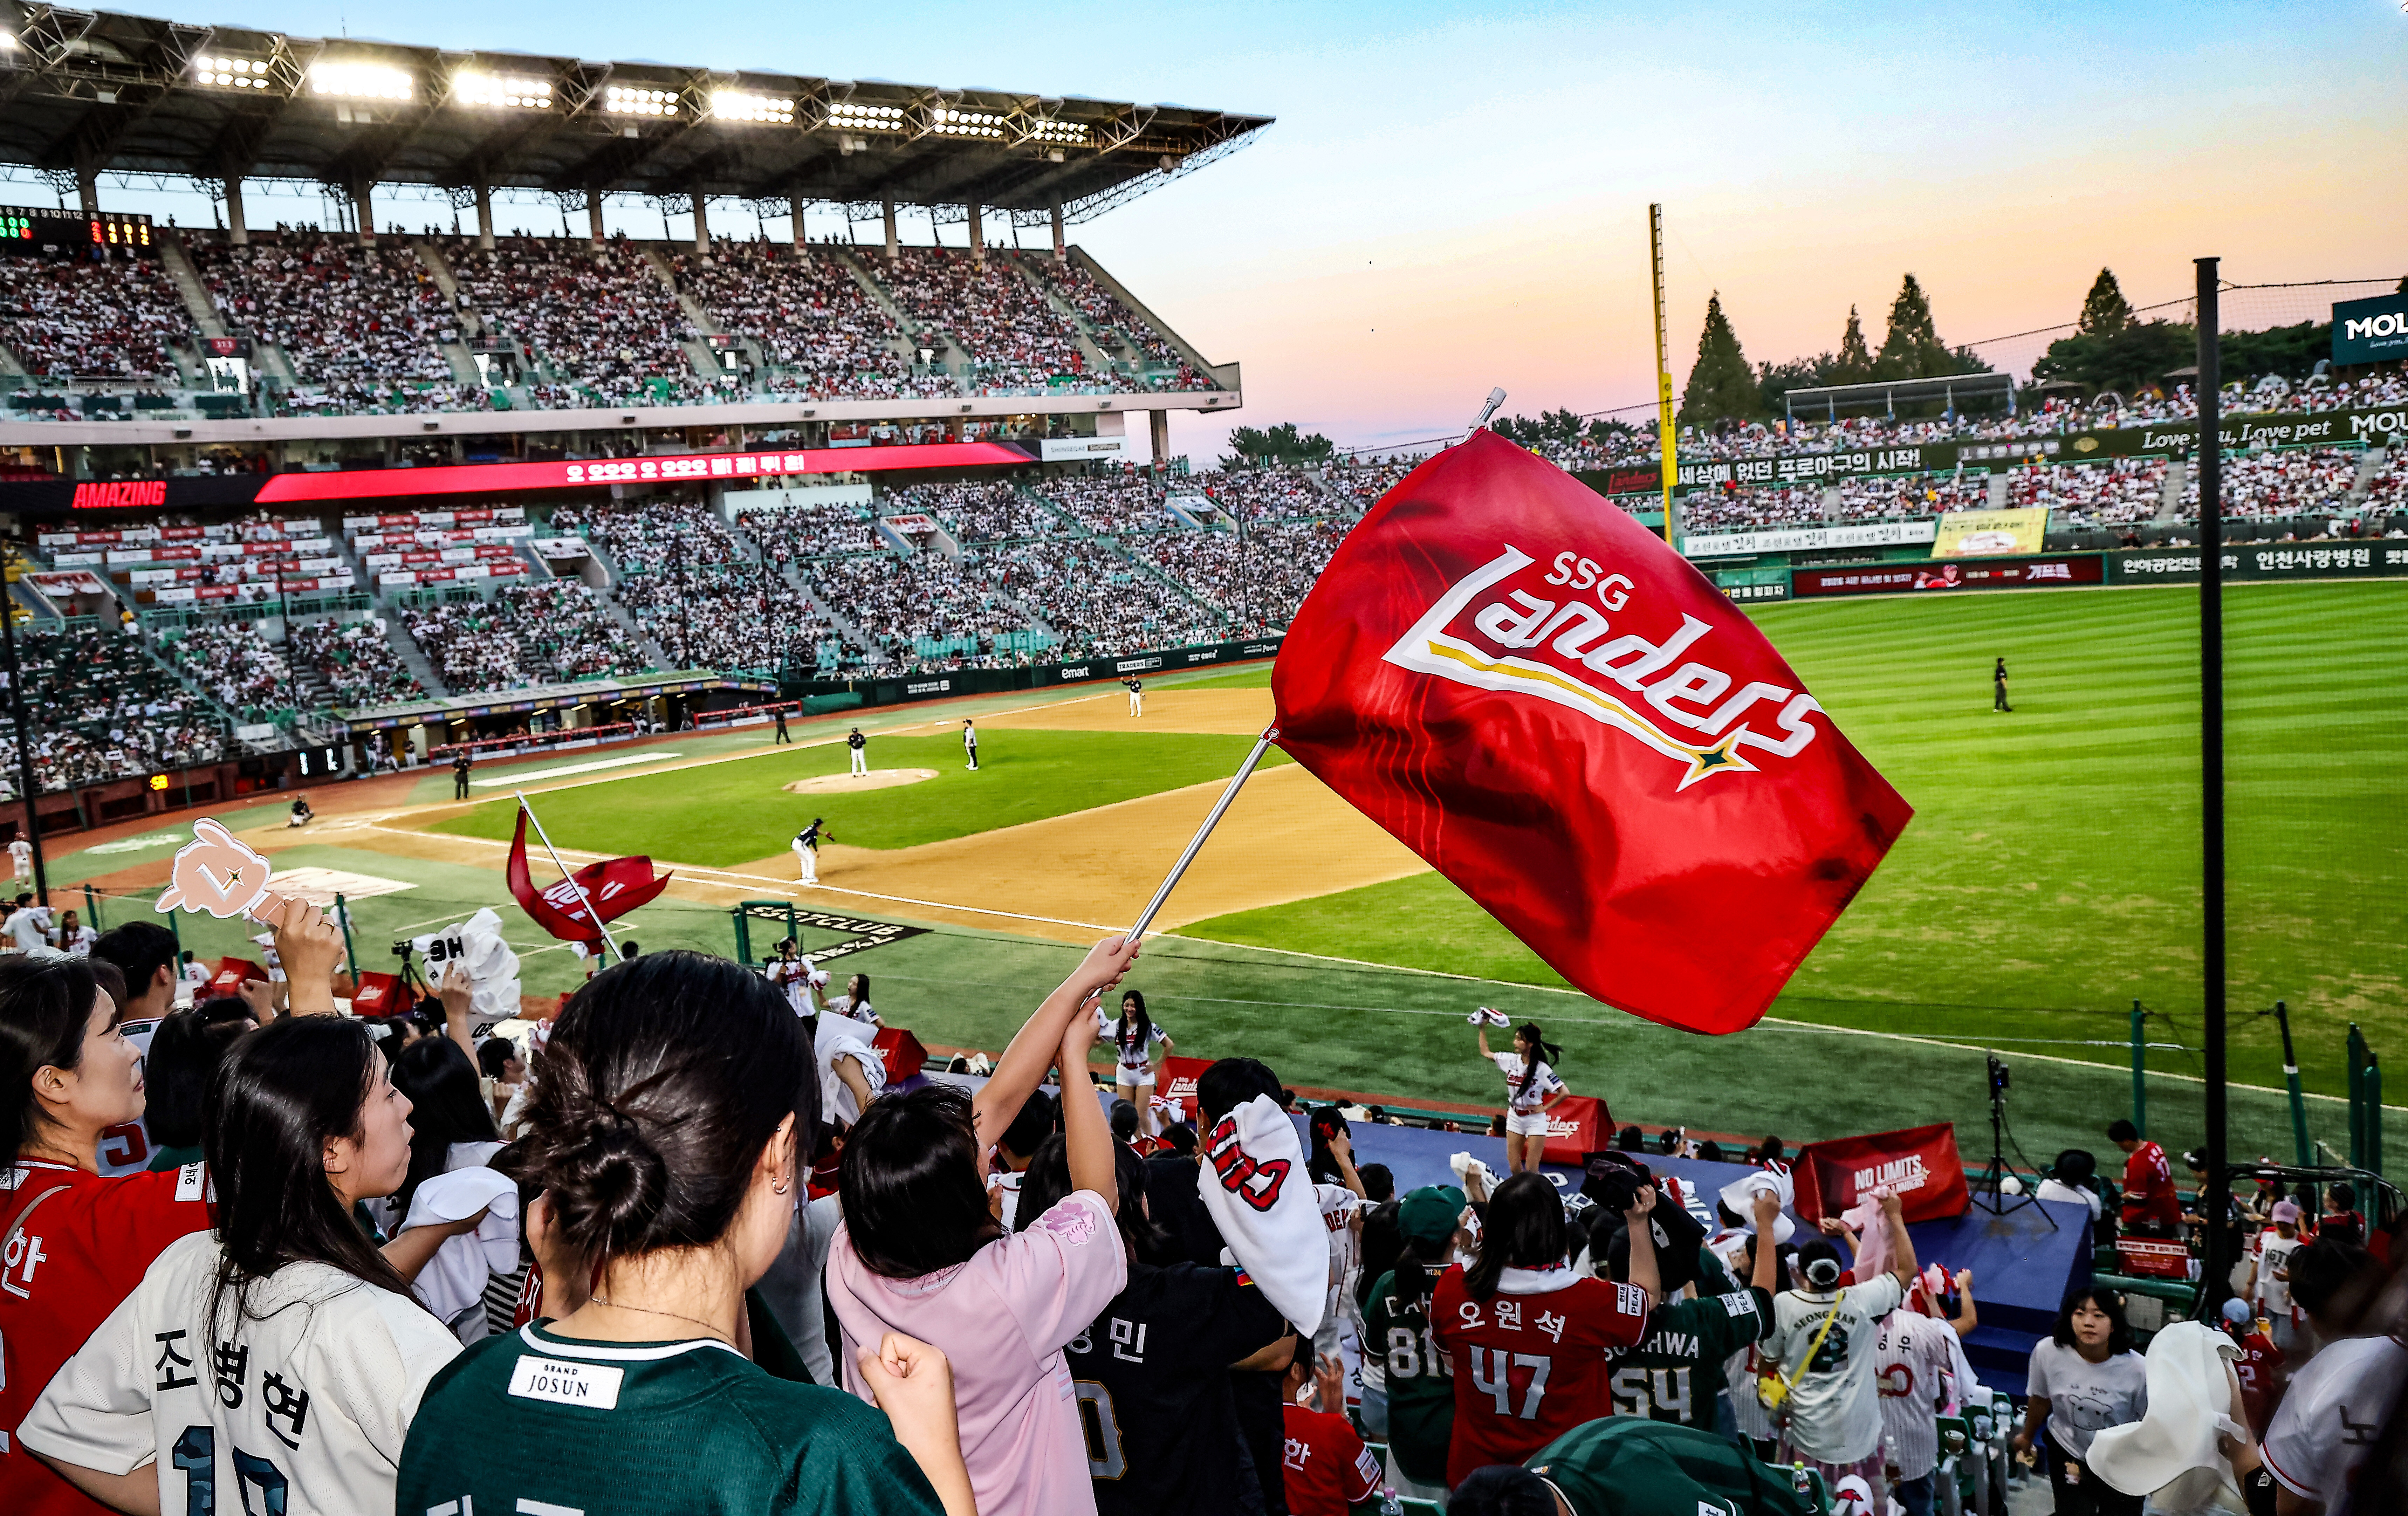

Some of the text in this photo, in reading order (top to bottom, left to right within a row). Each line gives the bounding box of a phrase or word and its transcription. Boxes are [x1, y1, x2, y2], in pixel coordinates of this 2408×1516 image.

[2142, 431, 2190, 449] Love
[2240, 424, 2291, 441] Love
[2293, 420, 2332, 441] pet
[1678, 448, 1921, 485] 세상에 없던 프로야구의 시작!
[73, 480, 167, 509] AMAZING
[2255, 548, 2371, 570] 인천사랑병원
[1544, 551, 1635, 611] SSG
[1062, 666, 1090, 679] emart
[1381, 543, 1828, 793] Landers
[1855, 1154, 1922, 1191] NO LIMITS
[1459, 1300, 1566, 1344] 오원석
[527, 1373, 590, 1399] JOSUN
[543, 1364, 578, 1375] GRAND
[1469, 1345, 1551, 1420] 47
[154, 1329, 309, 1451] 조병현
[1611, 1366, 1692, 1422] 54
